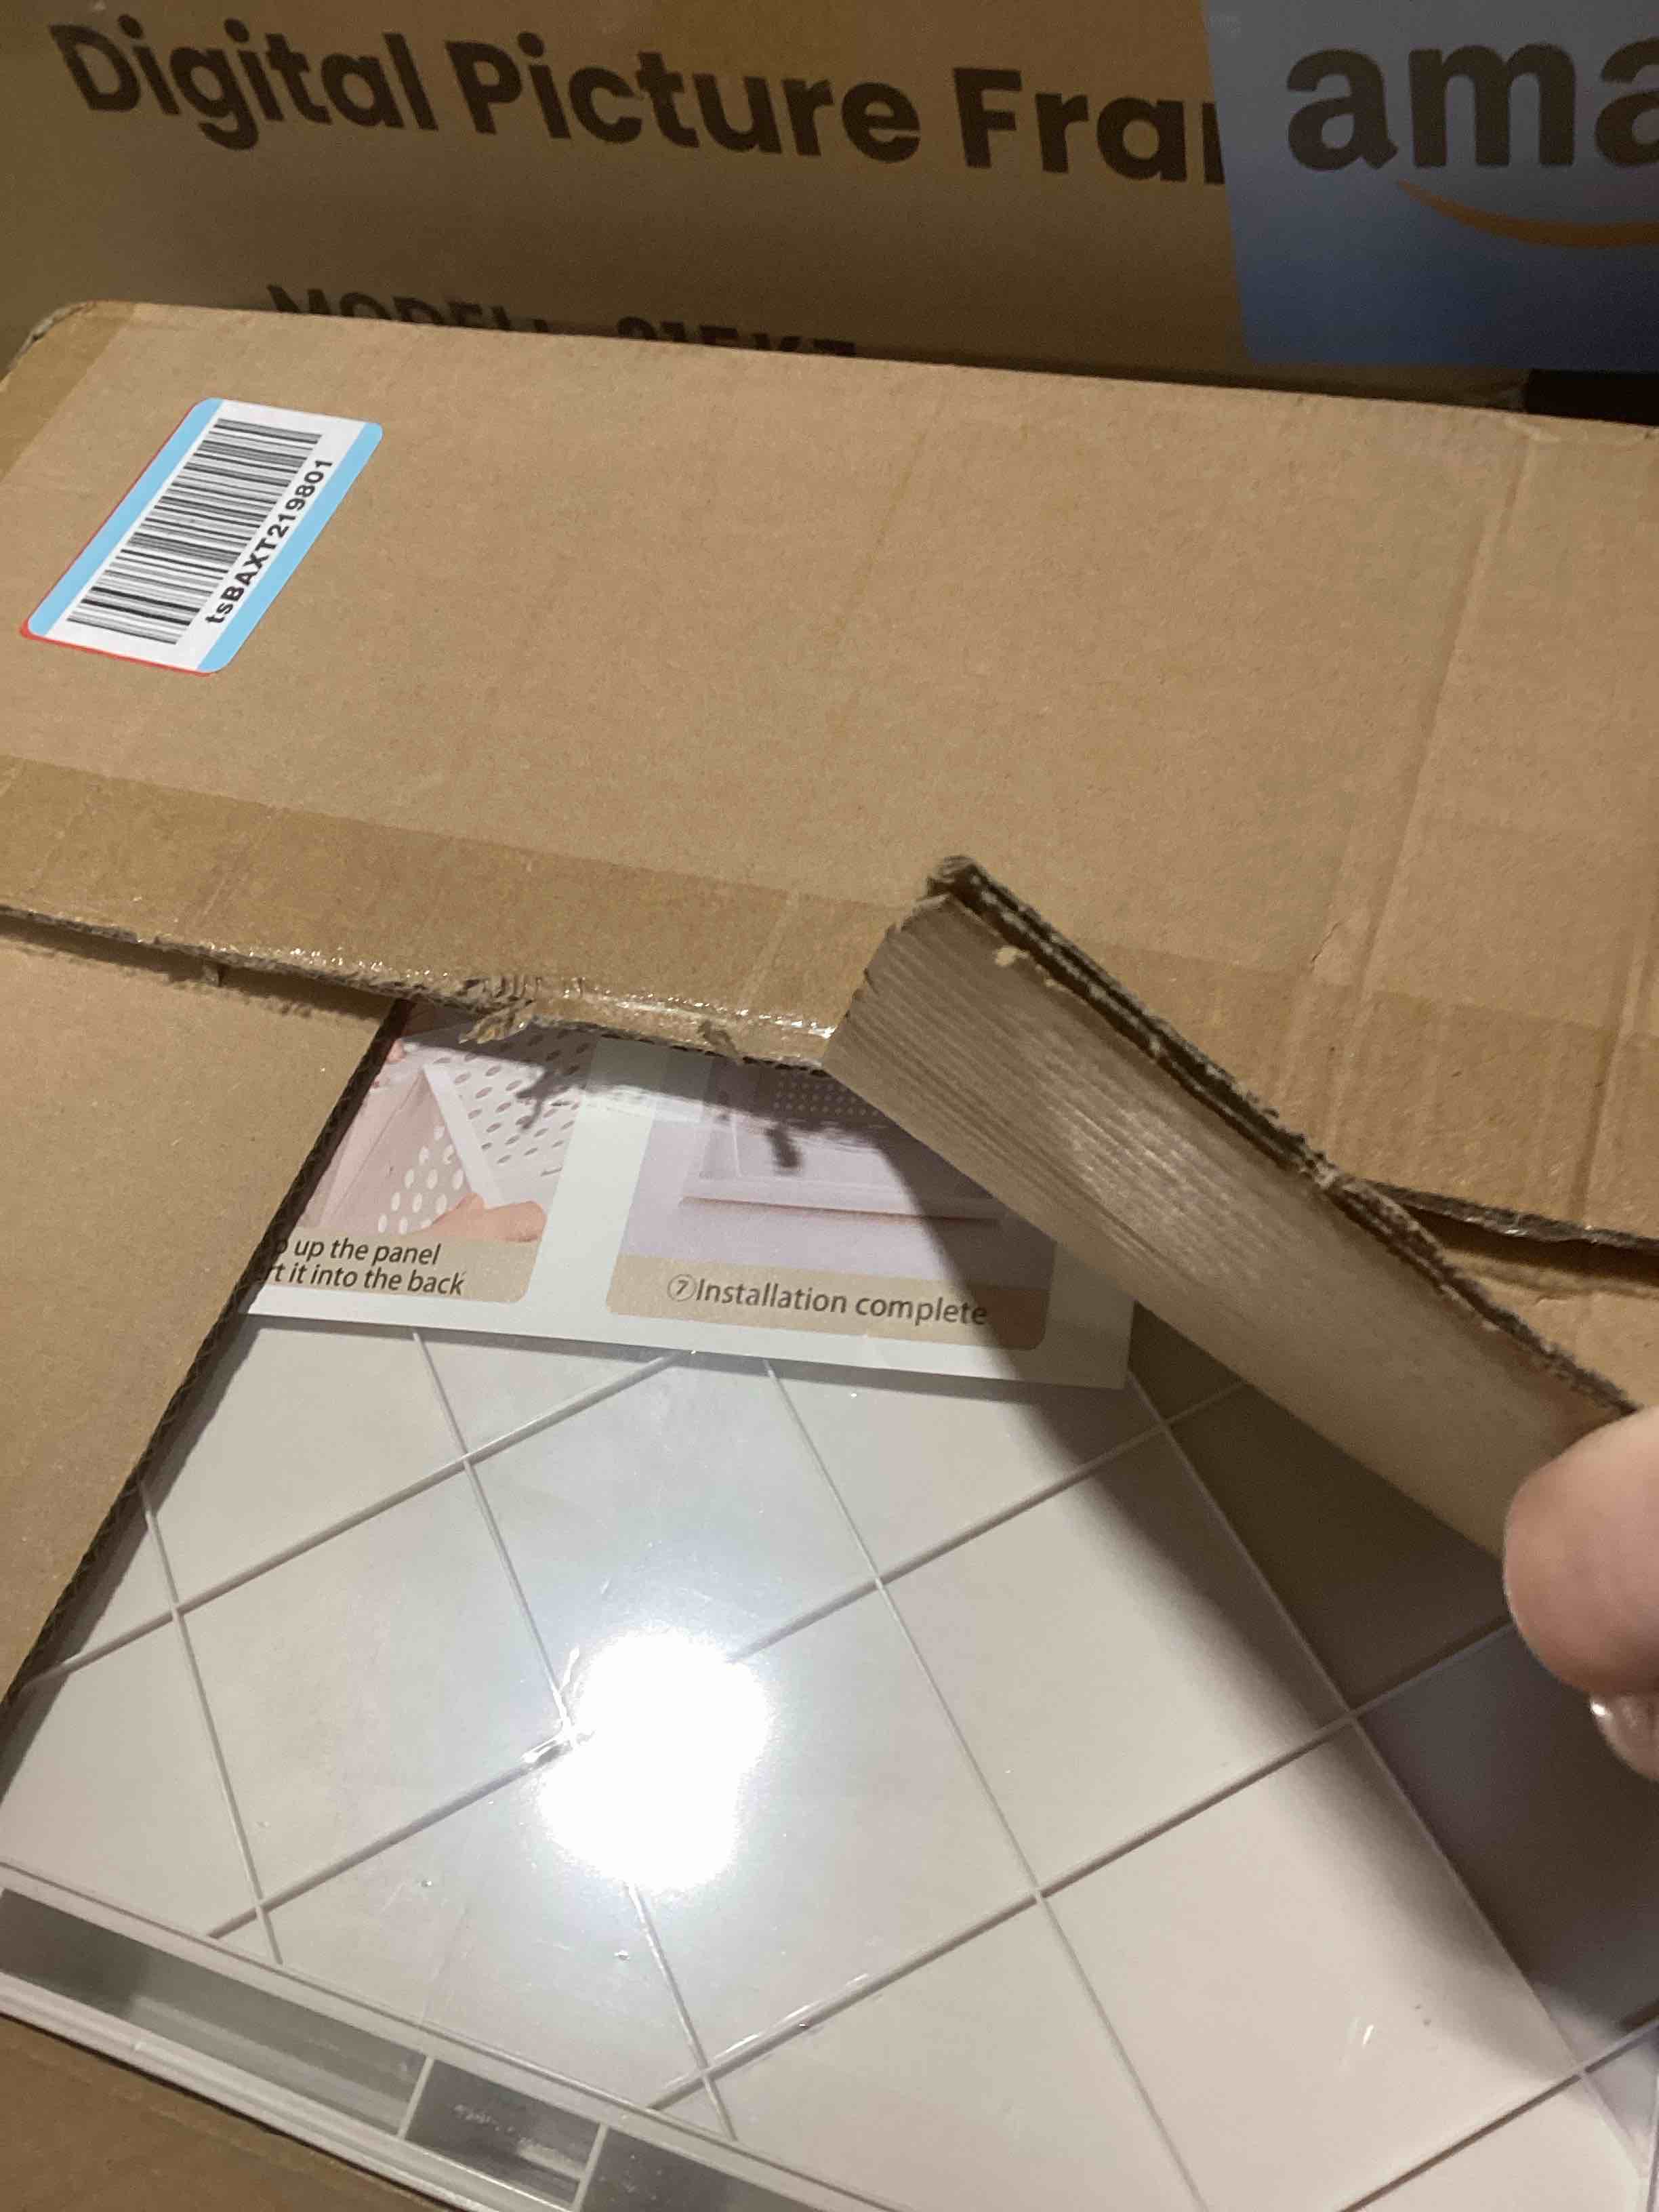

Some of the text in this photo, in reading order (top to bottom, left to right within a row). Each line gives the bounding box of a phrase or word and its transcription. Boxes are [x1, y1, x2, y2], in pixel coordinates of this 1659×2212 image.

[49, 14, 1225, 185] Digital Picture Fra
[206, 459, 333, 623] tsBAXT219801
[294, 1240, 325, 1262] up
[329, 1237, 371, 1261] the
[372, 1243, 442, 1266] panel
[289, 1263, 308, 1284] it
[310, 1264, 358, 1288] into
[361, 1265, 403, 1290] the
[407, 1269, 466, 1296] back
[856, 1297, 988, 1326] complete
